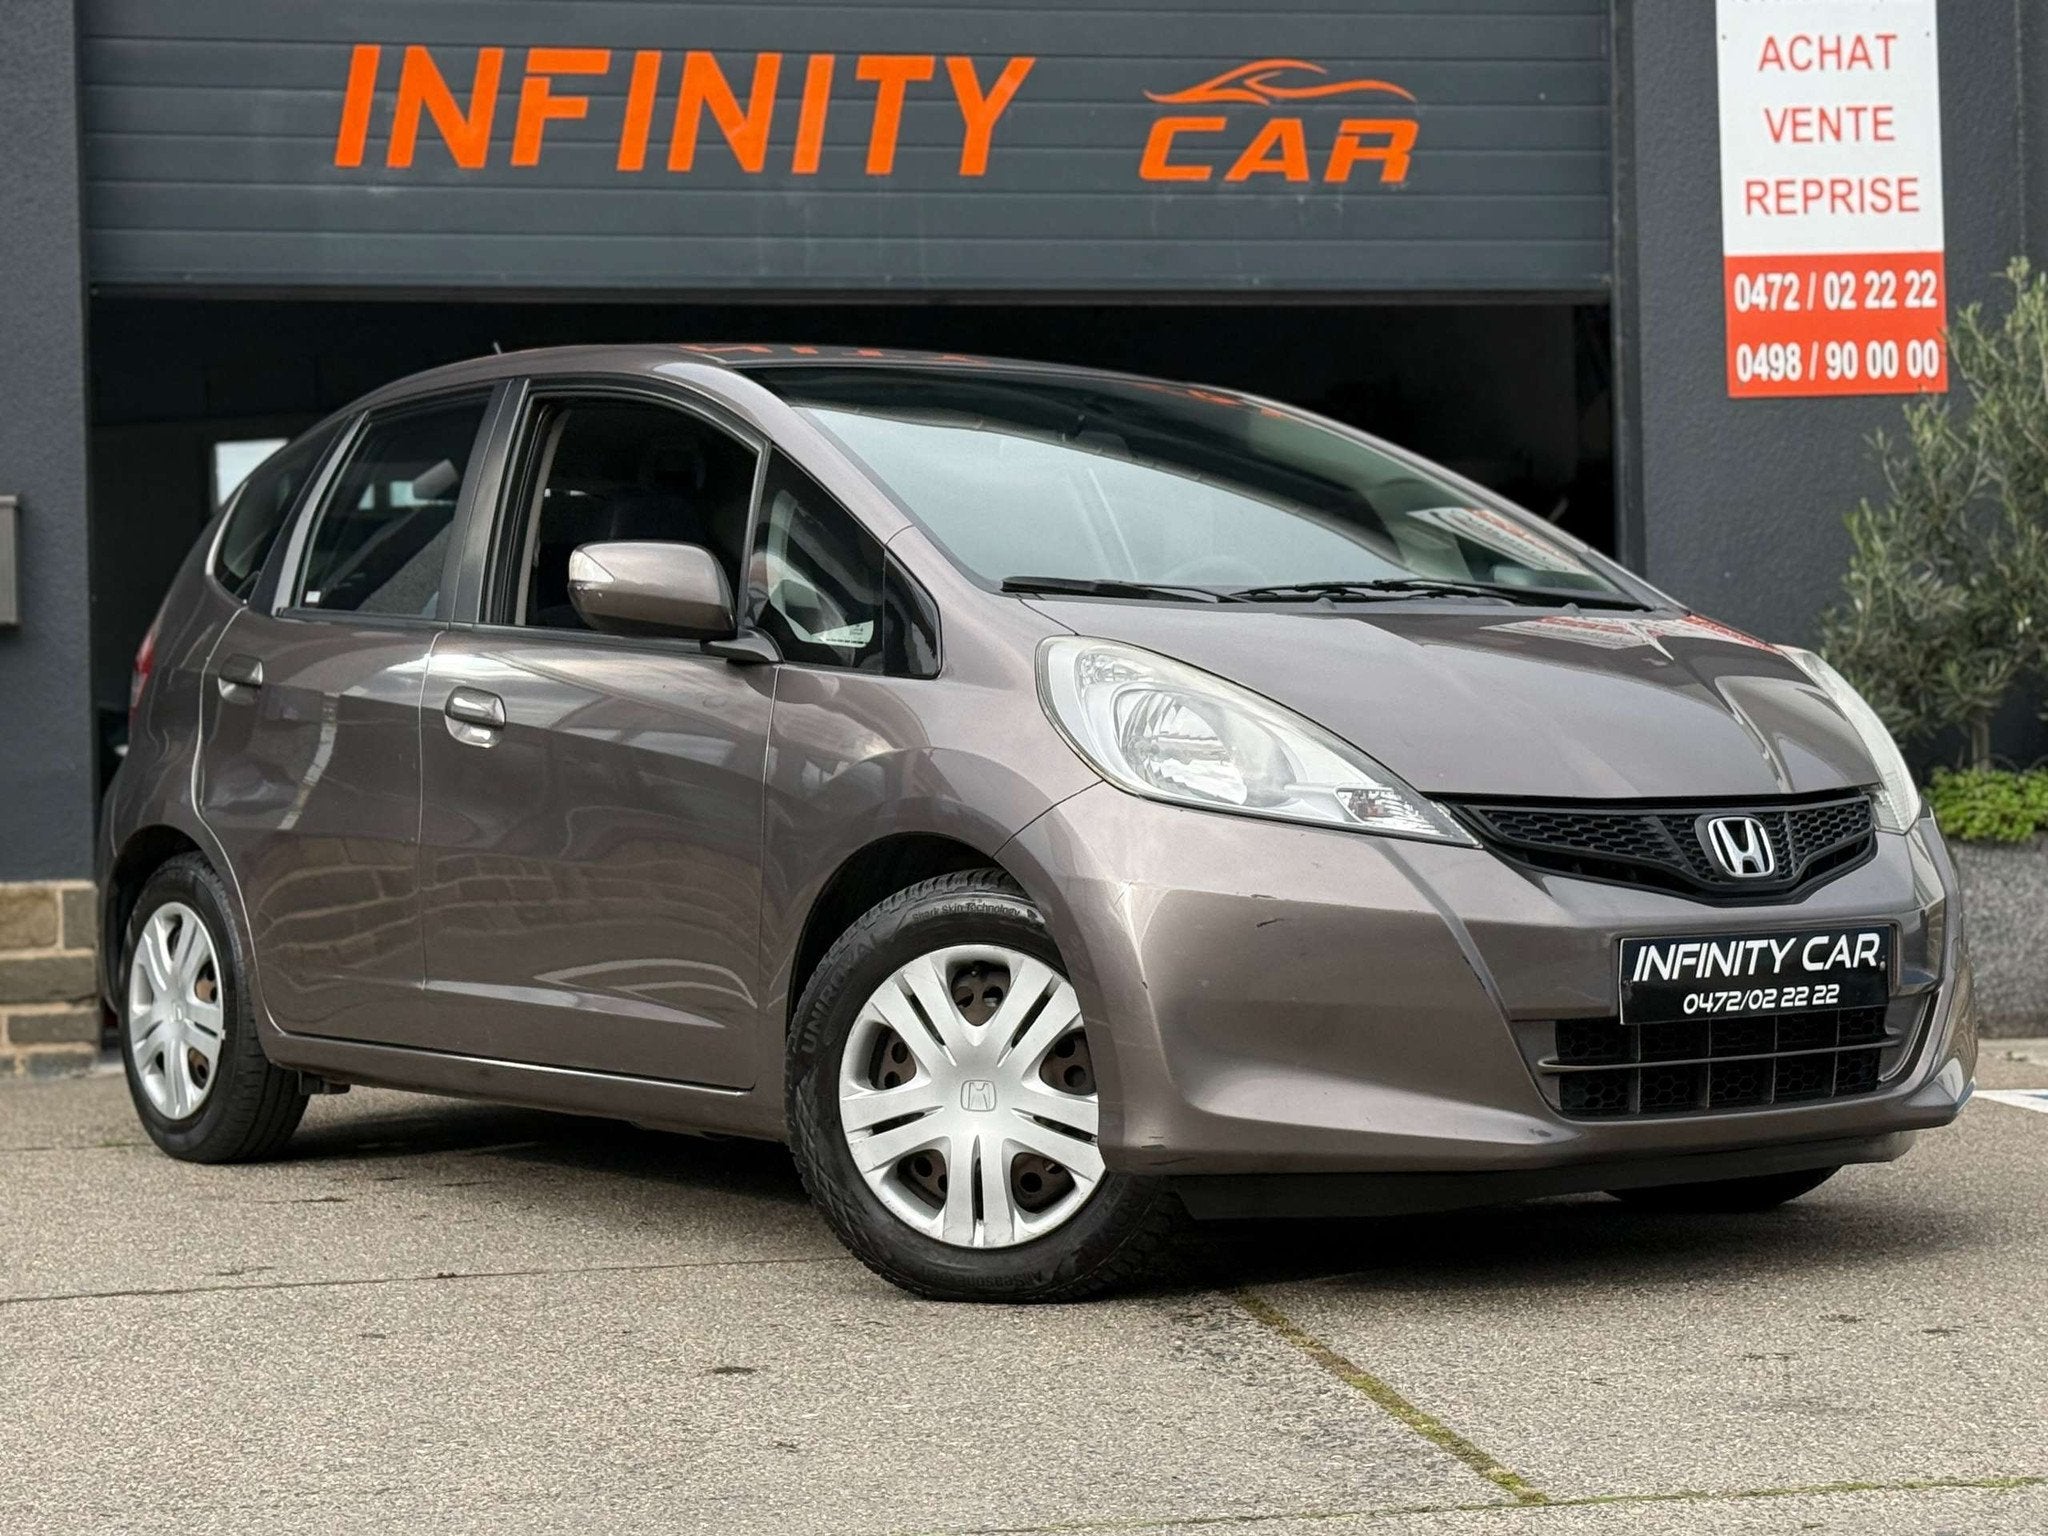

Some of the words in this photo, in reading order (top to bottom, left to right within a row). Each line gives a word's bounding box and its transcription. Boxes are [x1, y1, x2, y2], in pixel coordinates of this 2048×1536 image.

[1758, 33, 1898, 71] ACHAT
[334, 43, 1035, 177] INFINITY
[1138, 115, 1420, 184] CAR
[1764, 105, 1895, 144] VENTE
[1745, 176, 1920, 216] REPRISE
[1733, 271, 1801, 313] 0472
[1823, 270, 1858, 311] 02
[1863, 269, 1898, 310] 22
[1903, 268, 1938, 309] 22
[1735, 341, 1803, 383] 0498
[1824, 340, 1859, 381] 90
[1865, 339, 1900, 380] 00
[1905, 338, 1940, 379] 00
[1631, 936, 1798, 983] INFINITY
[1801, 931, 1882, 972] CAR
[1682, 987, 1778, 1016] 0472/02
[1779, 985, 1810, 1008] 22
[1811, 983, 1841, 1006] 22
